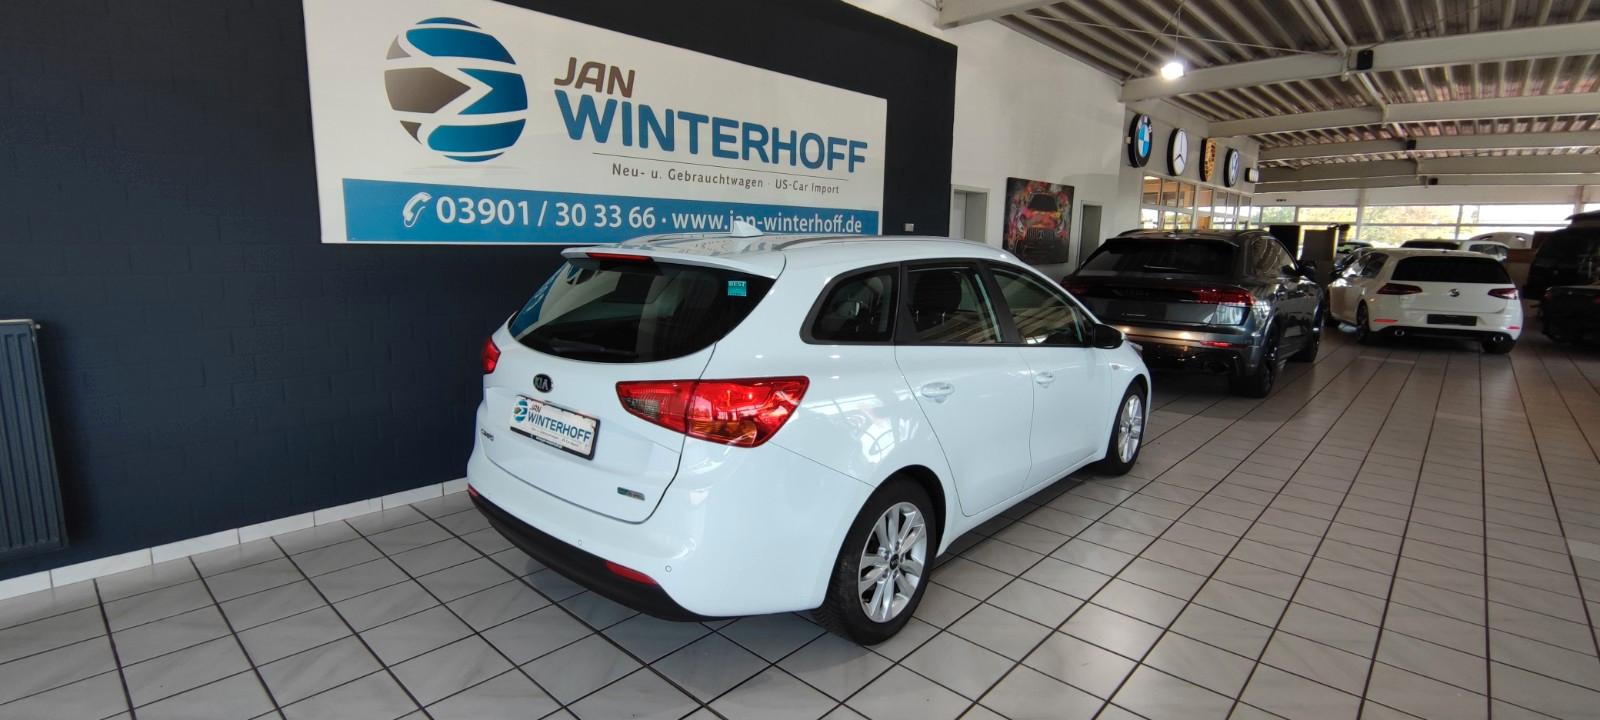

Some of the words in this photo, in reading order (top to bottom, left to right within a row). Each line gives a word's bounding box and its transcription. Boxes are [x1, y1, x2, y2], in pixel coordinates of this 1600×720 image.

[553, 56, 635, 98] JAN
[554, 88, 868, 173] WINTERHOFF
[612, 162, 645, 177] Neu-
[651, 168, 662, 180] u.
[668, 168, 763, 189] Gebrauchtwagen
[775, 178, 808, 192] US-Car
[811, 182, 840, 195] Import
[436, 196, 529, 226] 03901
[555, 202, 586, 227] 30
[593, 204, 622, 228] 33
[628, 206, 656, 229] 66
[527, 411, 592, 442] WINTERHOFF
